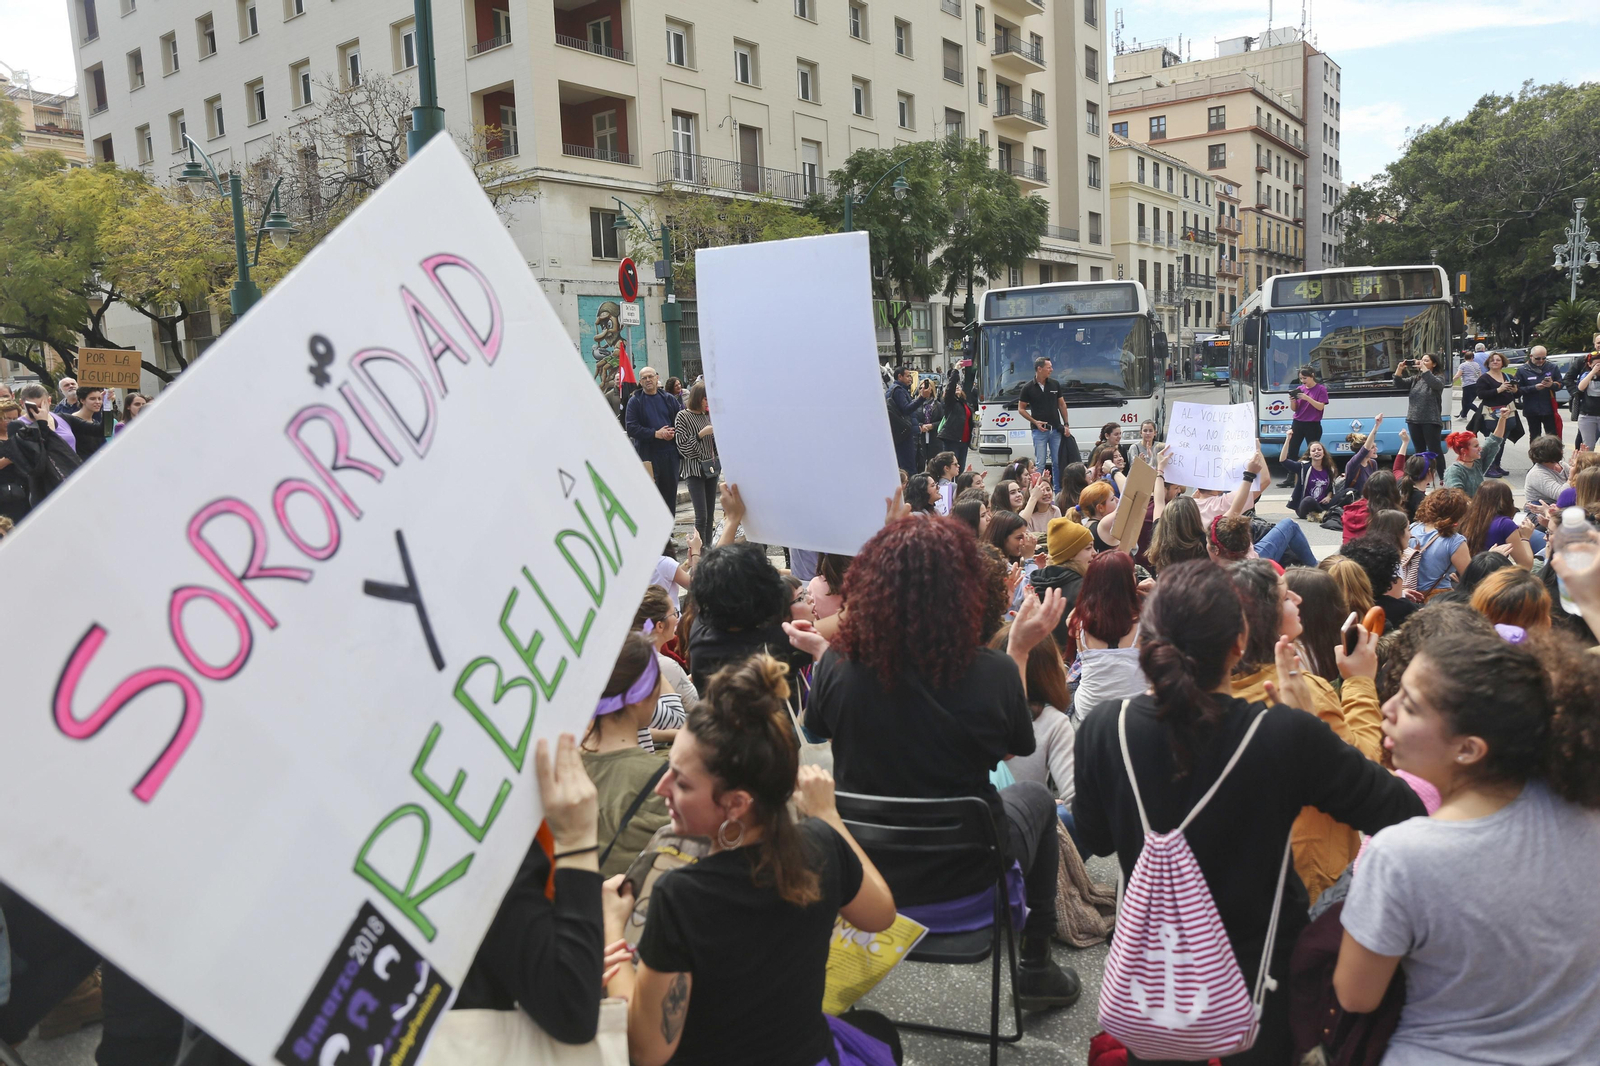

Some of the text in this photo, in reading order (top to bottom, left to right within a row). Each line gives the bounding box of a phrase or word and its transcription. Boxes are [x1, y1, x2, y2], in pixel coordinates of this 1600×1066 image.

[1294, 276, 1382, 299] 49 EMT
[1352, 284, 1382, 295] EMT
[1006, 299, 1027, 316] 33
[86, 352, 130, 365] POR LA
[80, 369, 140, 384] IGUALDAD
[1120, 413, 1138, 423] 461
[1181, 407, 1193, 419] AL
[1200, 409, 1234, 423] VOLVER
[1175, 424, 1197, 438] CASA
[1206, 429, 1219, 440] NO
[1178, 440, 1191, 449] SER
[1167, 453, 1184, 468] SER
[52, 252, 504, 804] SORORIDAD
[363, 528, 447, 673] Y
